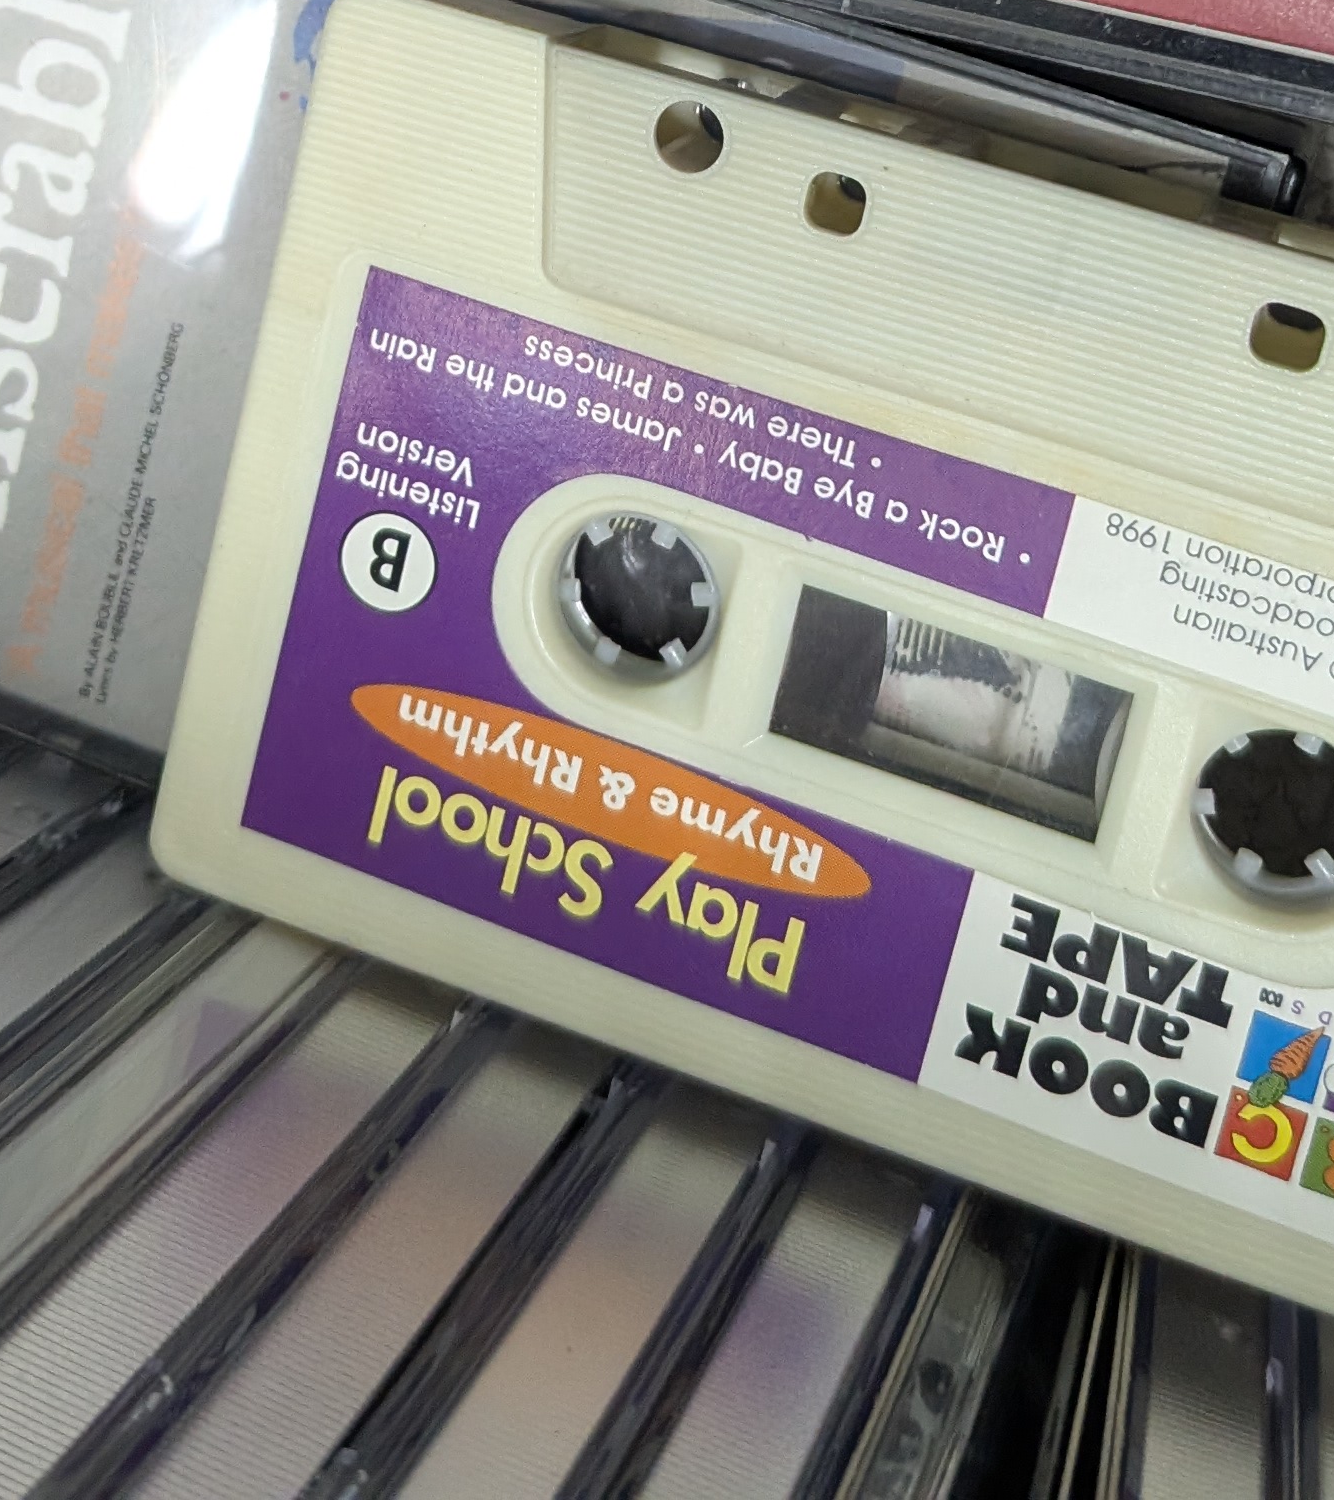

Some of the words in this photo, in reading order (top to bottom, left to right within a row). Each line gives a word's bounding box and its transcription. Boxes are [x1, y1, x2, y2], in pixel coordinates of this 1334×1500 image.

[363, 323, 439, 373] Rain
[439, 349, 499, 394] the
[519, 329, 656, 399] Princess
[498, 368, 570, 417] and
[569, 391, 684, 455] James
[659, 376, 687, 405] a
[691, 385, 760, 428] was
[350, 418, 478, 486] Version
[714, 434, 807, 495] Baby
[759, 408, 862, 467] There
[330, 445, 485, 528] Listening
[809, 465, 880, 519] Bye
[881, 495, 912, 525] a
[358, 521, 418, 593] B
[913, 506, 1008, 563] Rock
[1101, 510, 1176, 556] 1998
[109, 577, 137, 644] HERBERT
[126, 493, 159, 576] KRETZMER
[1166, 602, 1325, 674] Australian
[388, 683, 590, 795] Rhythm
[587, 761, 639, 813] &
[370, 765, 617, 924] School
[638, 773, 831, 884] Rhyme
[640, 842, 813, 996] Play
[1004, 891, 1231, 1027] TAPE
[1013, 962, 1195, 1066] and
[955, 1000, 1210, 1149] BOOK
